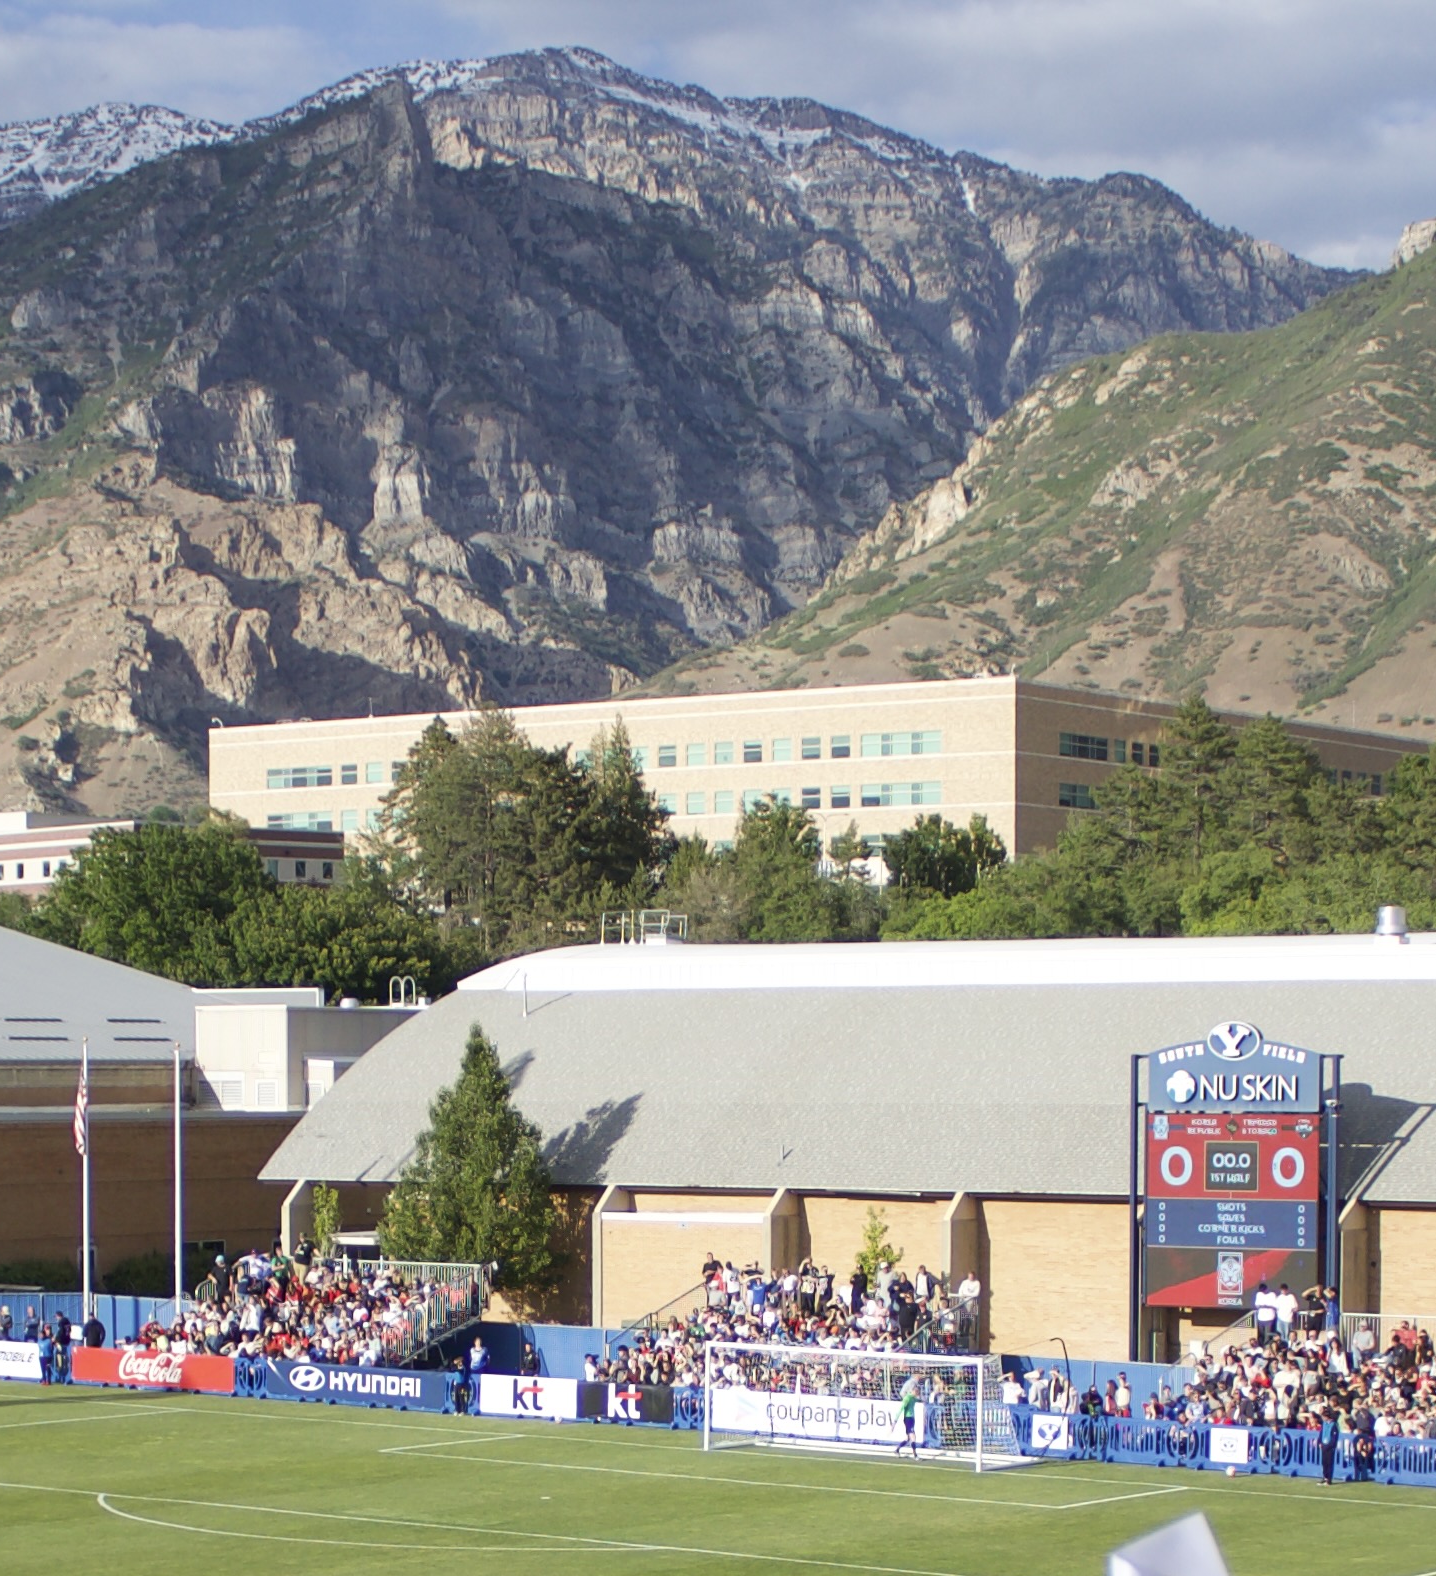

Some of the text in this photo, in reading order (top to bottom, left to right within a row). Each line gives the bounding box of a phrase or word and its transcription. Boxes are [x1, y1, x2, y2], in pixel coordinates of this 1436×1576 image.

[1158, 1044, 1305, 1064] SOUTH FIELD
[1200, 1074, 1298, 1101] NU SKIN
[1160, 1145, 1193, 1186] 0
[1271, 1146, 1305, 1188] 0
[1158, 1202, 1166, 1211] 0
[1297, 1204, 1305, 1214] 0
[1158, 1213, 1166, 1222] 0
[1297, 1216, 1305, 1225] 0
[1158, 1224, 1166, 1233] 0
[1297, 1226, 1305, 1236] 0
[1158, 1234, 1166, 1244] 0
[1297, 1237, 1305, 1247] 0
[329, 1369, 421, 1398] HYUNDAI
[512, 1378, 544, 1411] kt
[608, 1383, 643, 1419] kt
[766, 1401, 850, 1430] coupang
